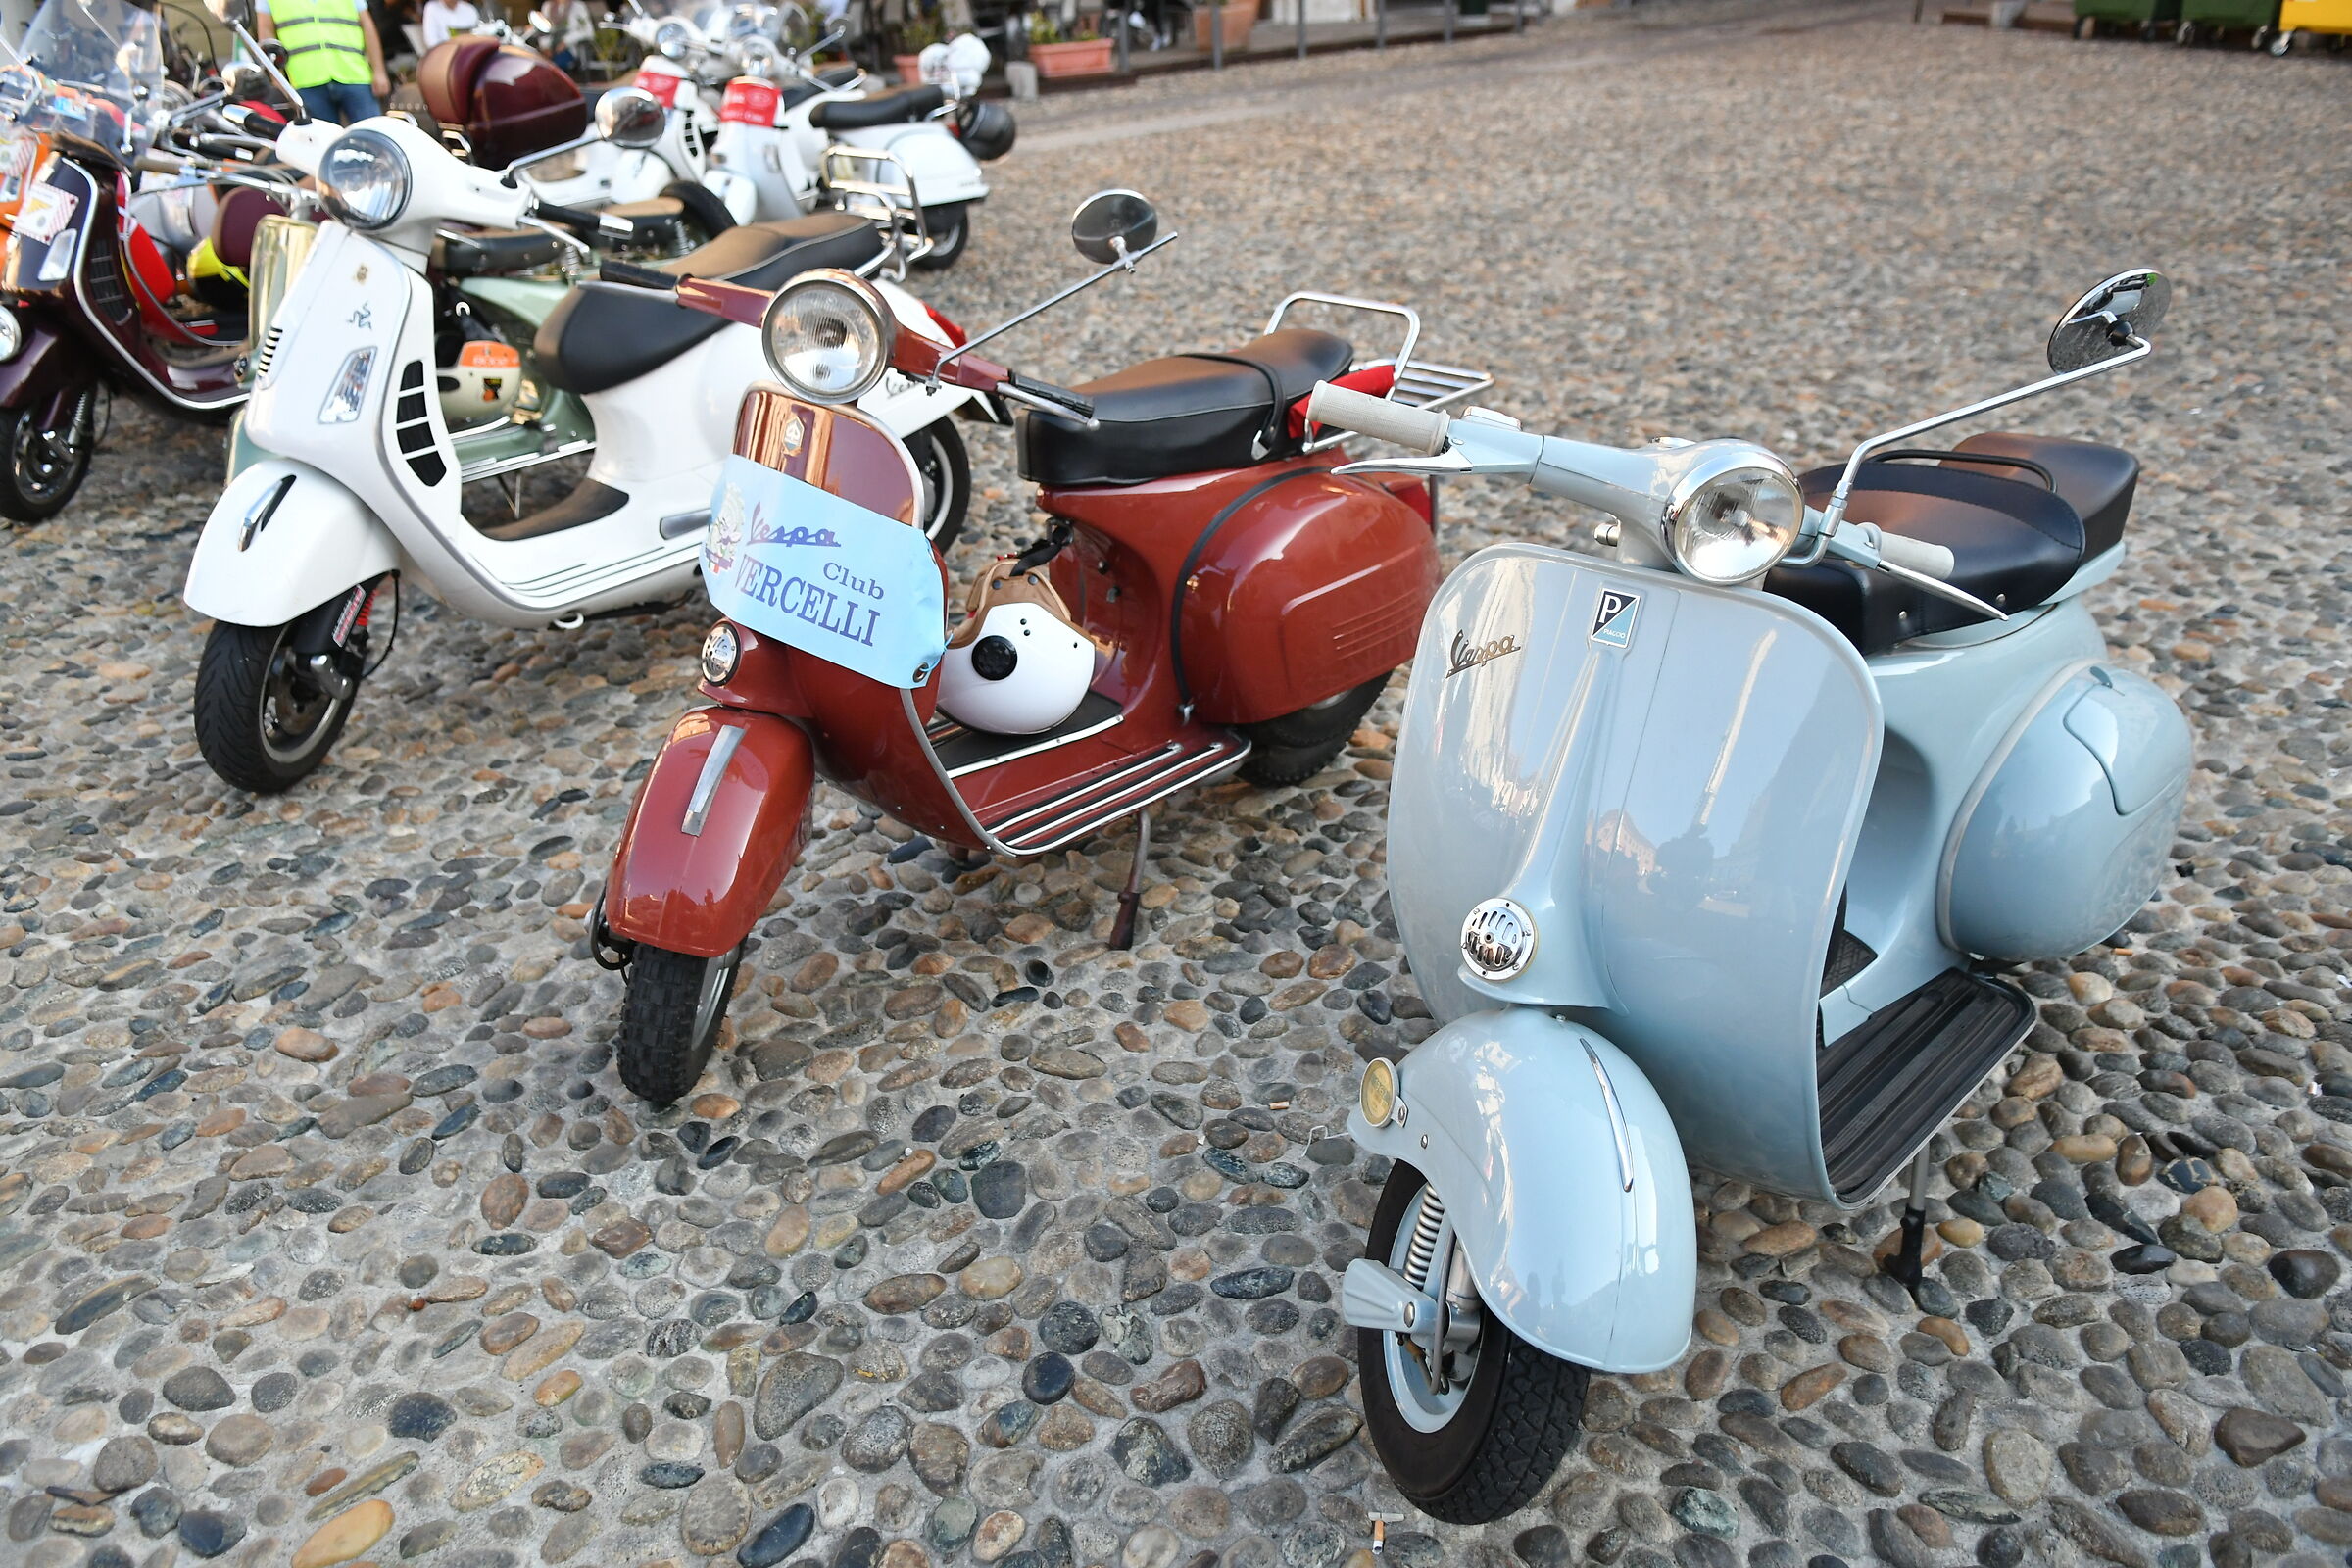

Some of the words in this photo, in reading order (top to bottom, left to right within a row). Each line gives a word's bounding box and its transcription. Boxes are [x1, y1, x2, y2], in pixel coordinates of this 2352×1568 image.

[746, 501, 842, 548] Vespa
[735, 553, 881, 648] VERCELLI
[822, 562, 885, 601] Club
[1598, 594, 1622, 624] P
[1446, 629, 1522, 679] Vespa
